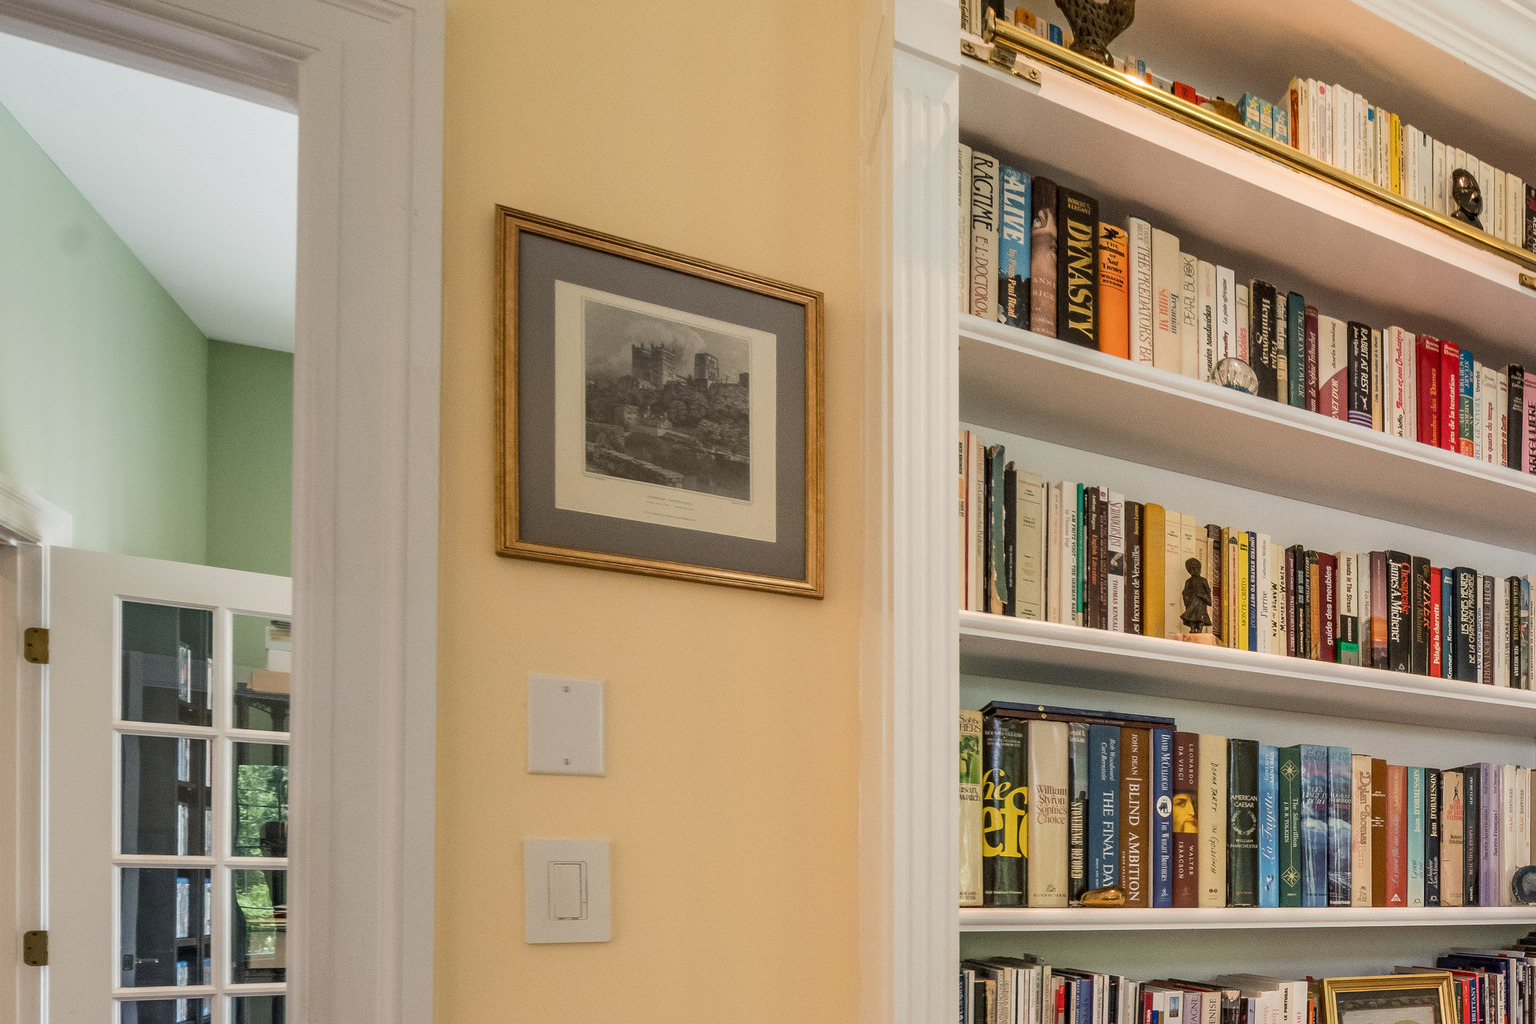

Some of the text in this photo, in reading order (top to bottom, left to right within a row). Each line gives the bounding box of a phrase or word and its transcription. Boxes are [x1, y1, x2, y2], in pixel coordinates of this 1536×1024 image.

[972, 155, 993, 232] RAGTIME
[1002, 171, 1025, 245] ALIVE
[1067, 216, 1093, 341] DYNASTY
[1138, 245, 1149, 271] THE
[1004, 297, 1016, 318] Read
[1158, 288, 1168, 332] SHIBUMI
[1256, 298, 1270, 368] Hemingway
[1132, 545, 1140, 578] Versailles
[1325, 566, 1333, 602] meubles
[1389, 559, 1401, 643] James Michener
[1401, 562, 1411, 615] Chesapeake
[1422, 580, 1432, 629] FIXER
[1325, 622, 1333, 645] guide
[1433, 642, 1441, 664] Pélagie
[1483, 630, 1491, 660] GHOST
[1036, 784, 1067, 795] William
[1038, 794, 1066, 805] Styron
[1129, 783, 1140, 826] BLIND
[1359, 772, 1372, 845] Dylan Thomas
[1037, 814, 1066, 825] Choice
[1102, 791, 1114, 860] THE FINAL
[1262, 793, 1278, 842] Fayette
[1161, 833, 1169, 855] WRIGHT
[1129, 832, 1140, 902] AMBITION
